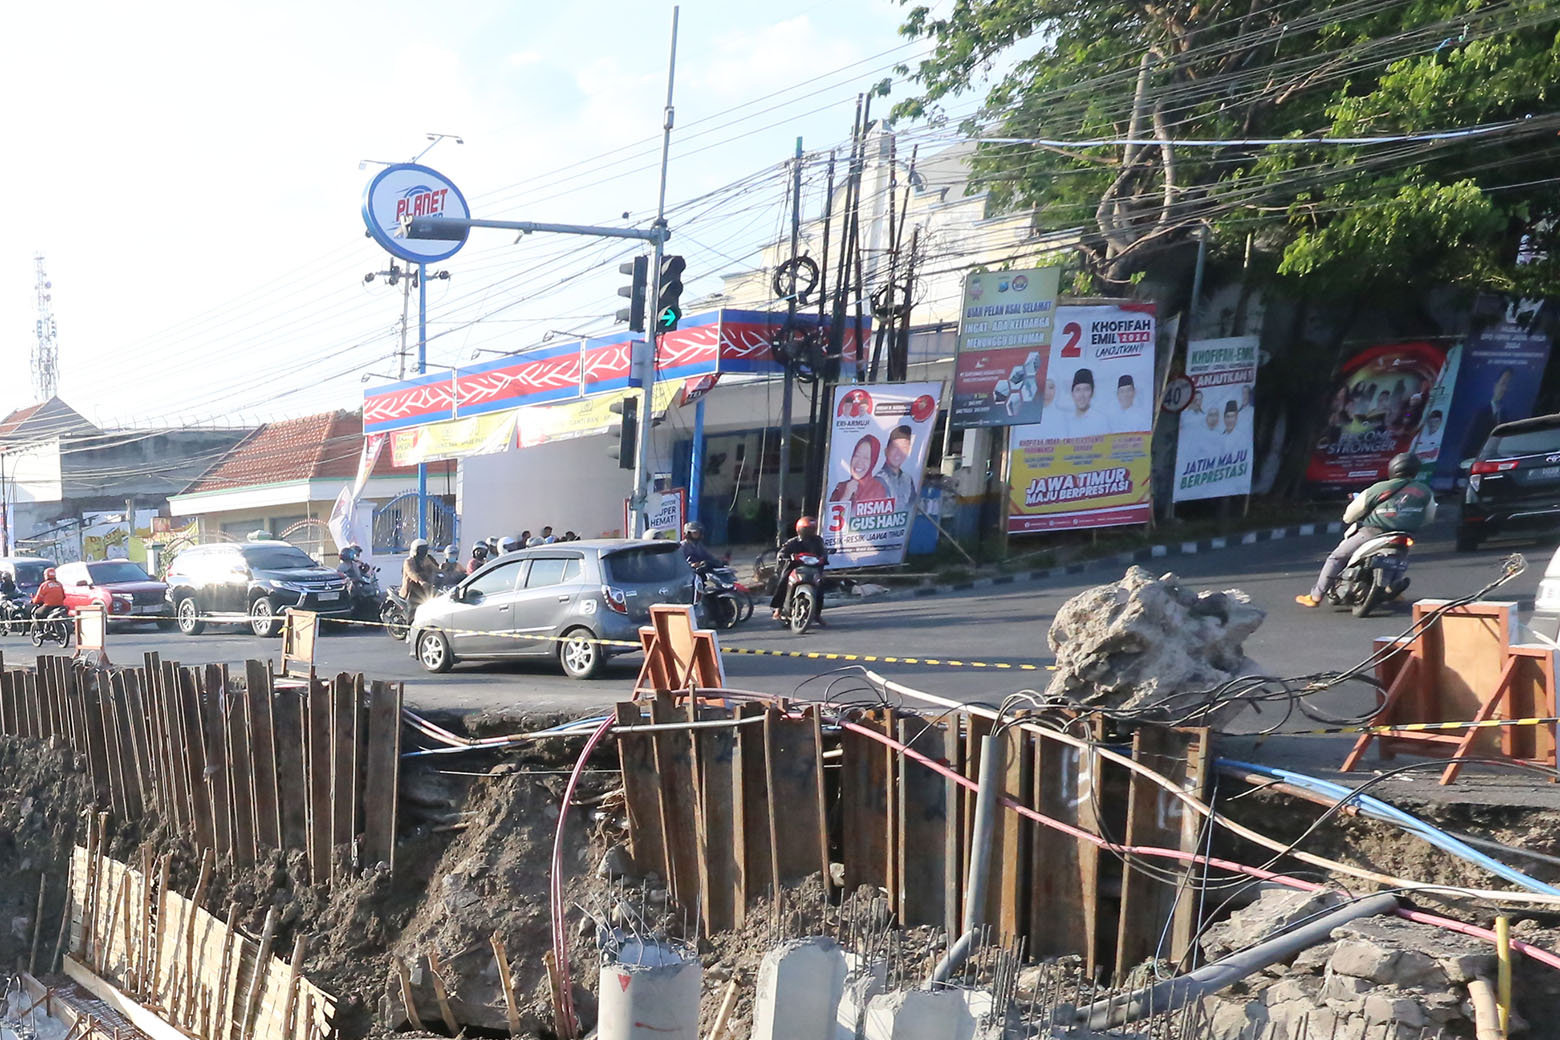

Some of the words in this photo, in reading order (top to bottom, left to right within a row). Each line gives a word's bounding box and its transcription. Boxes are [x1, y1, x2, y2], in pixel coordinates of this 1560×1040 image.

[396, 188, 448, 222] PLANET
[984, 304, 1003, 316] PELAN
[1005, 303, 1021, 315] ASAL
[1023, 301, 1052, 313] SELAMAT
[1091, 319, 1151, 332] KHOFIFAH
[1061, 322, 1081, 357] 2
[1091, 333, 1117, 345] EMIL
[1121, 333, 1148, 342] 2024
[1163, 386, 1181, 405] 40
[1327, 440, 1398, 454] STRONGER
[1182, 458, 1216, 476] JATIM
[1217, 449, 1248, 467] MAJU
[1026, 474, 1075, 494] JAWA
[1078, 468, 1127, 487] TIMUR
[1180, 462, 1248, 490] BERPRESTASI
[1025, 490, 1058, 505] MAJU
[1059, 480, 1130, 500] BERPRESTASI
[655, 505, 677, 518] UPER
[856, 501, 893, 515] RISMA
[650, 514, 677, 527] HEMAT!
[829, 505, 845, 532] 3
[850, 516, 876, 531] GUS
[876, 512, 907, 528] HANS
[866, 532, 888, 542] JAWA
